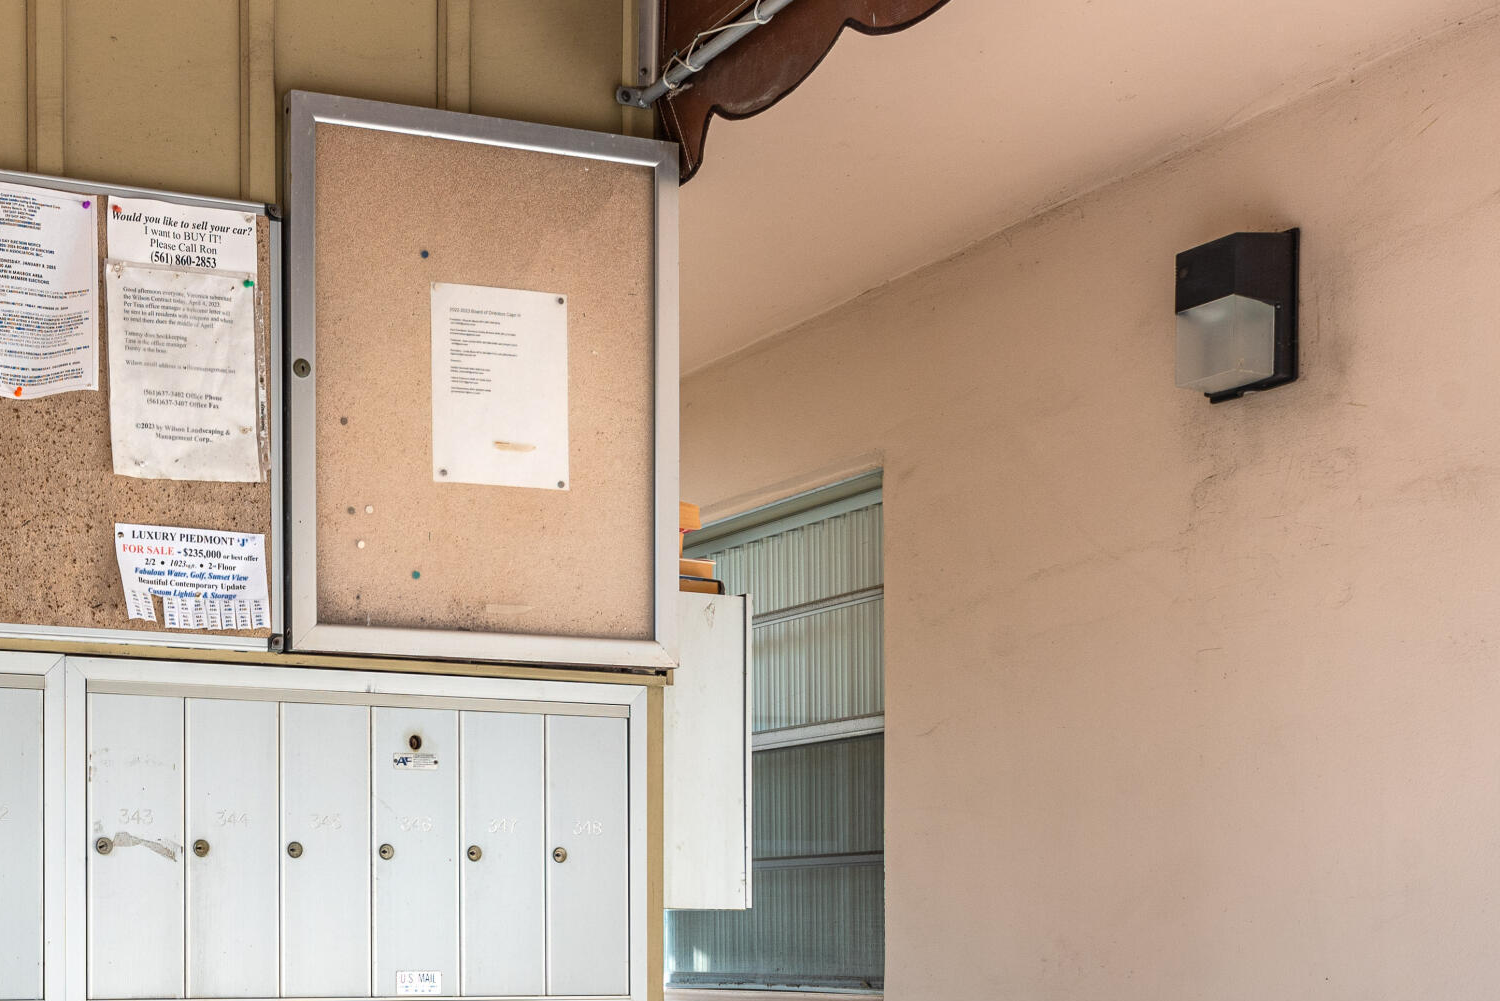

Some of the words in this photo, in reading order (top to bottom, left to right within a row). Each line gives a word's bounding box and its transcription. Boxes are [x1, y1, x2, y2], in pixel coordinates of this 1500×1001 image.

[112, 211, 142, 222] Would
[143, 215, 160, 224] you
[162, 217, 178, 227] like
[181, 220, 189, 228] to
[192, 222, 208, 230] sell
[210, 225, 230, 233] your
[232, 227, 252, 236] car?
[144, 226, 148, 234] I
[151, 228, 170, 238] want
[173, 231, 181, 239] to
[184, 232, 206, 242] BUY
[209, 234, 222, 244] IT!
[150, 238, 176, 251] Please
[178, 243, 197, 252] Call
[200, 244, 217, 255] Ron
[150, 251, 173, 265] (561)
[175, 254, 217, 268] 860-2853
[132, 530, 176, 542] LUXURY
[180, 533, 234, 546] PIEDMONT
[122, 544, 144, 554] FOR
[147, 546, 174, 555] SALE
[183, 548, 221, 559] $235,000
[134, 567, 165, 576] Fabulous
[168, 569, 188, 578] Water,
[190, 571, 206, 580] Golf,
[138, 577, 168, 586] Beautiful
[170, 580, 218, 590] Contemporary
[221, 583, 246, 591] Update
[148, 588, 172, 596] Custom
[173, 590, 202, 598] Lightin
[210, 592, 236, 600] Storage
[118, 808, 154, 825] 343
